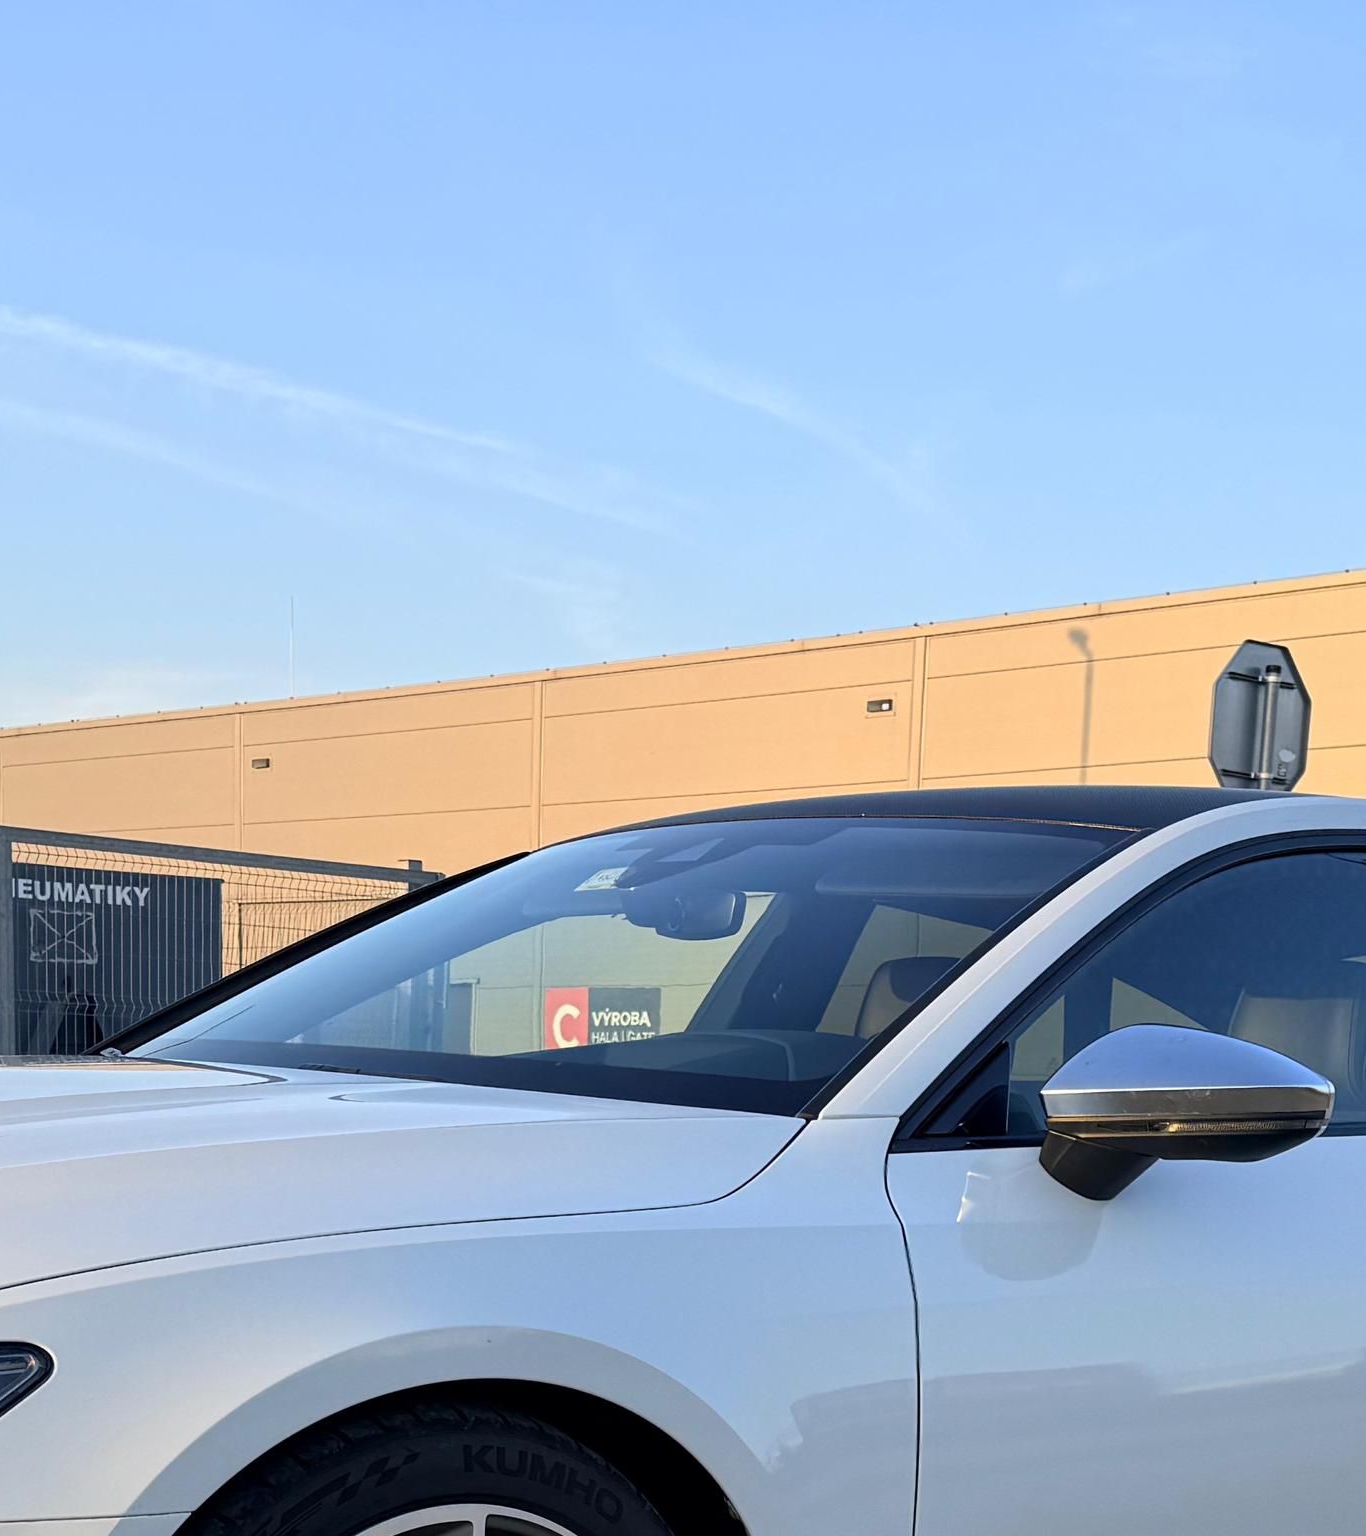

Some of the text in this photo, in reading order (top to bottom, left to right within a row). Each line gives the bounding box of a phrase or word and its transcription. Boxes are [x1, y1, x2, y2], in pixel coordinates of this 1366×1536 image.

[552, 1003, 580, 1049] C
[591, 1007, 652, 1028] VÝROBA
[591, 1031, 619, 1044] HALA
[462, 1443, 624, 1524] KUMHO
